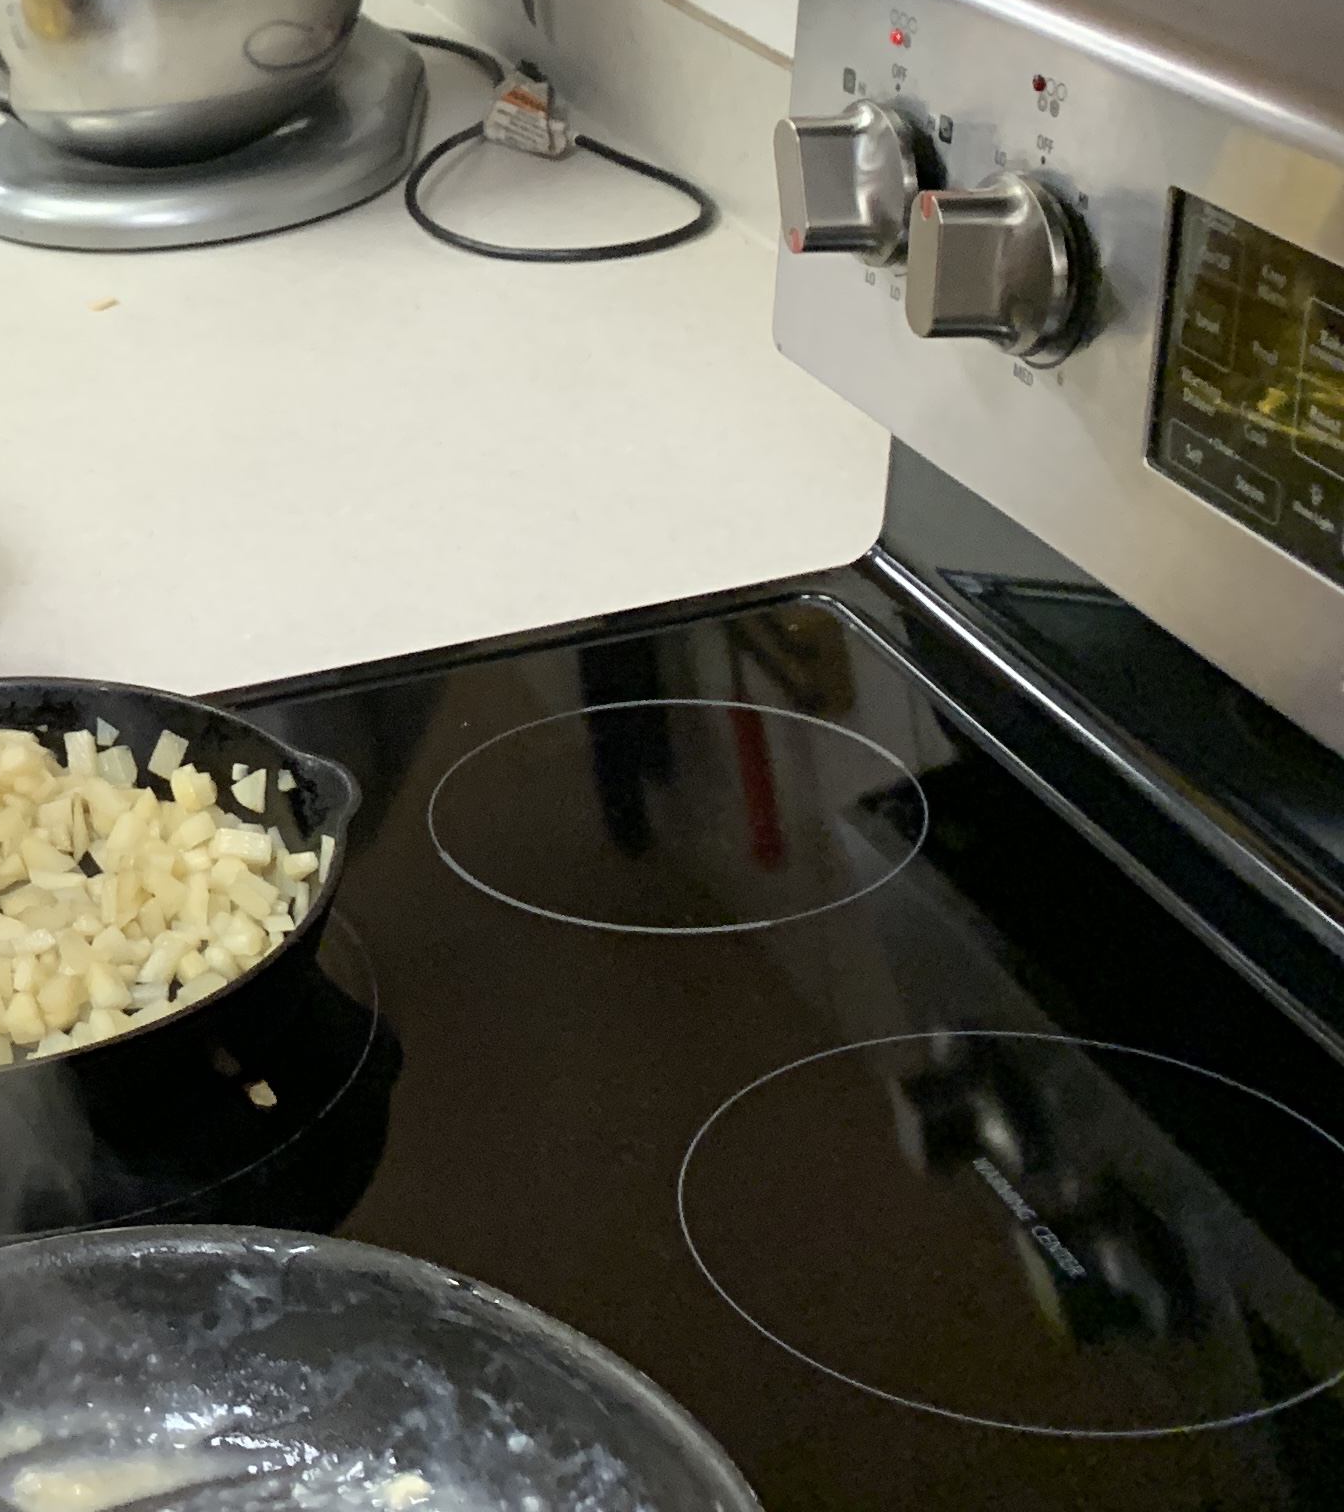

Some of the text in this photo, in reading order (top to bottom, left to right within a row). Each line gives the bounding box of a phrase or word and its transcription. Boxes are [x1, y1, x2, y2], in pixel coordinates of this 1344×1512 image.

[892, 63, 908, 82] OFF
[1036, 134, 1054, 154] OFF
[994, 150, 1007, 167] LO
[865, 268, 876, 287] LO
[889, 283, 901, 303] LO
